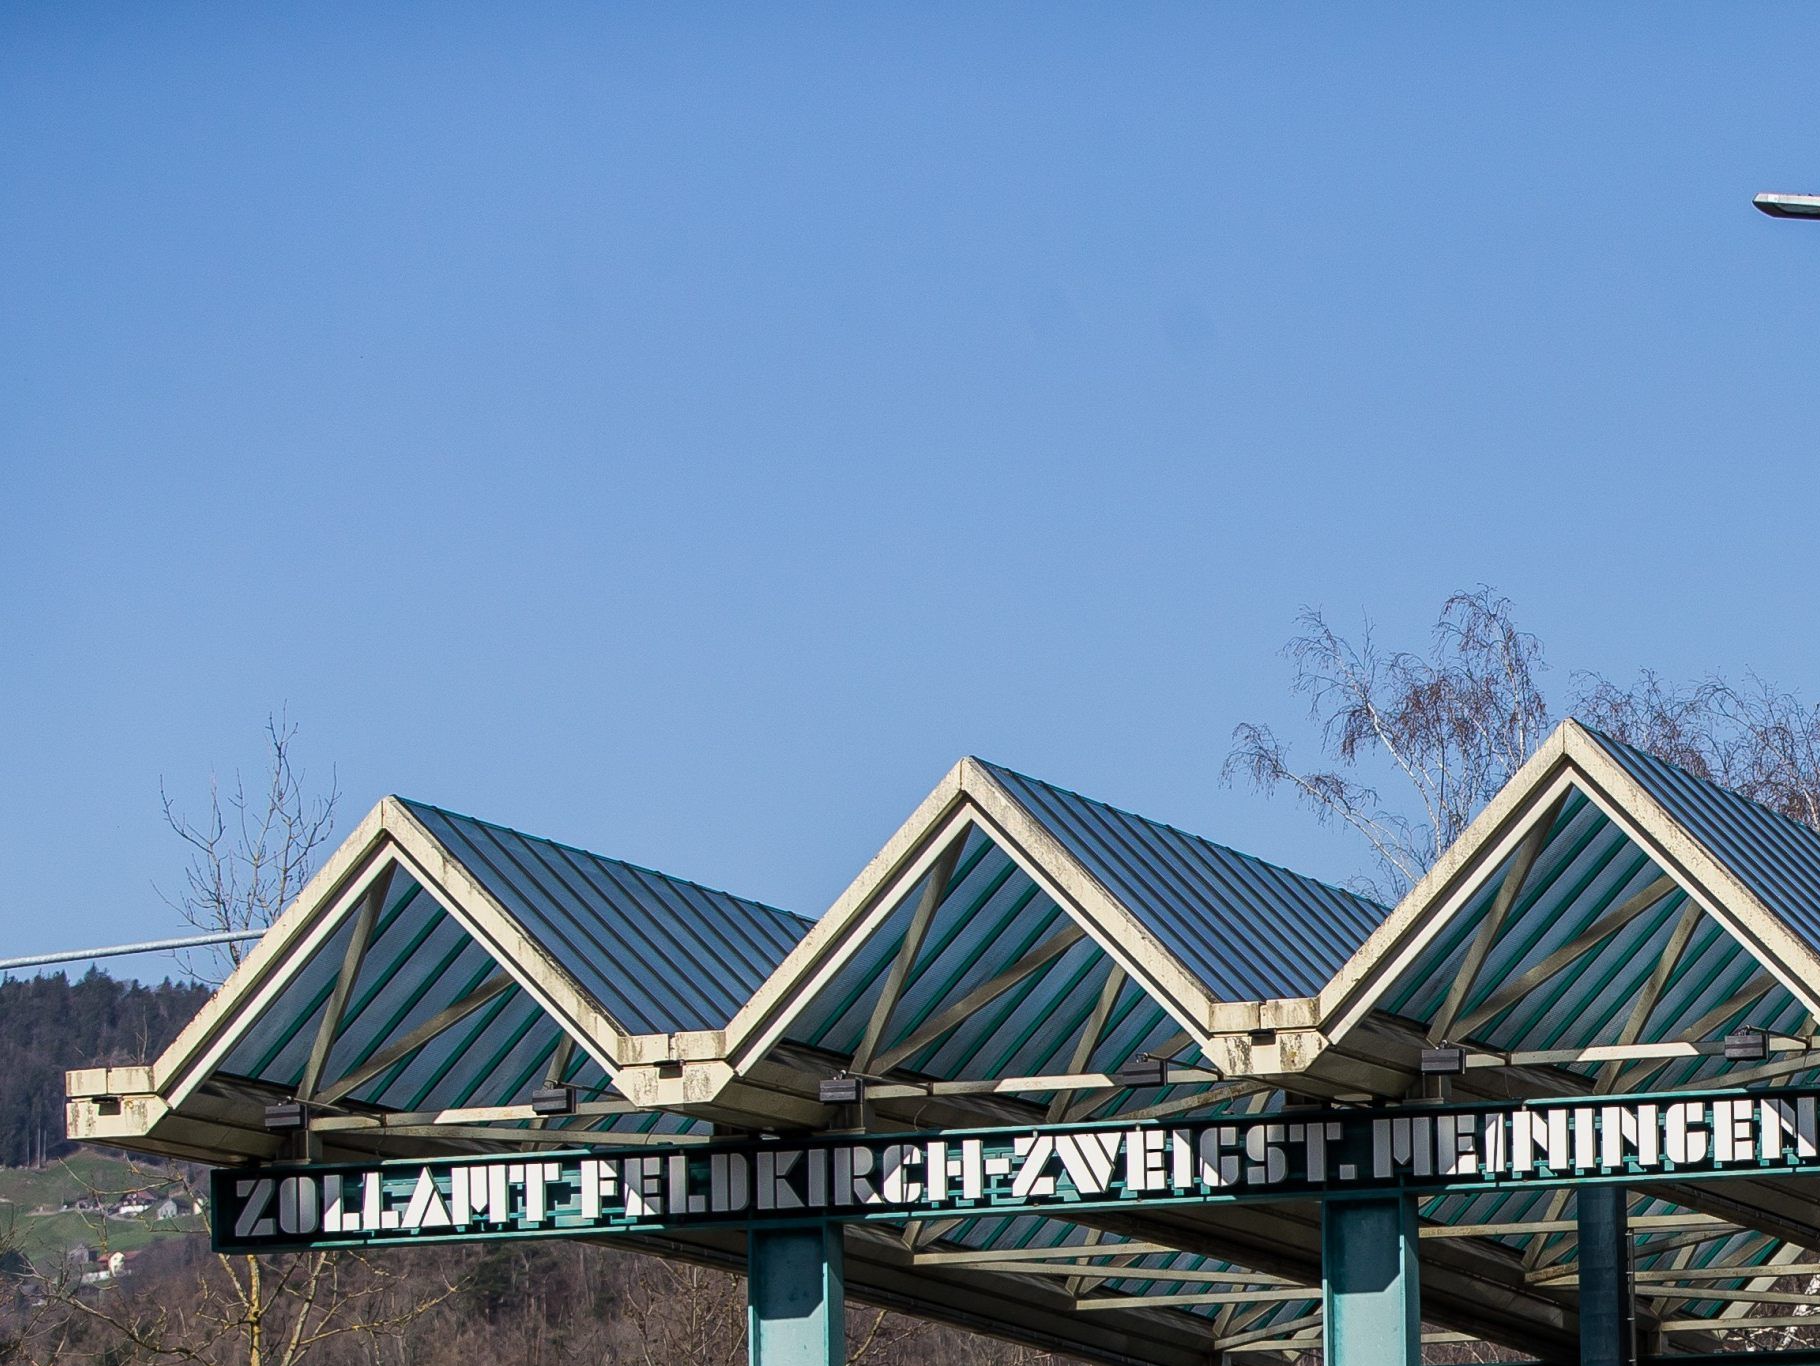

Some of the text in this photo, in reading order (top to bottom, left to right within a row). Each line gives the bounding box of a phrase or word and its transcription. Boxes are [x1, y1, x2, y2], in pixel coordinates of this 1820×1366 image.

[234, 1096, 1818, 1237] ZOLLAMT FELDKIRCH-ZWEIGST. MEININGEN
